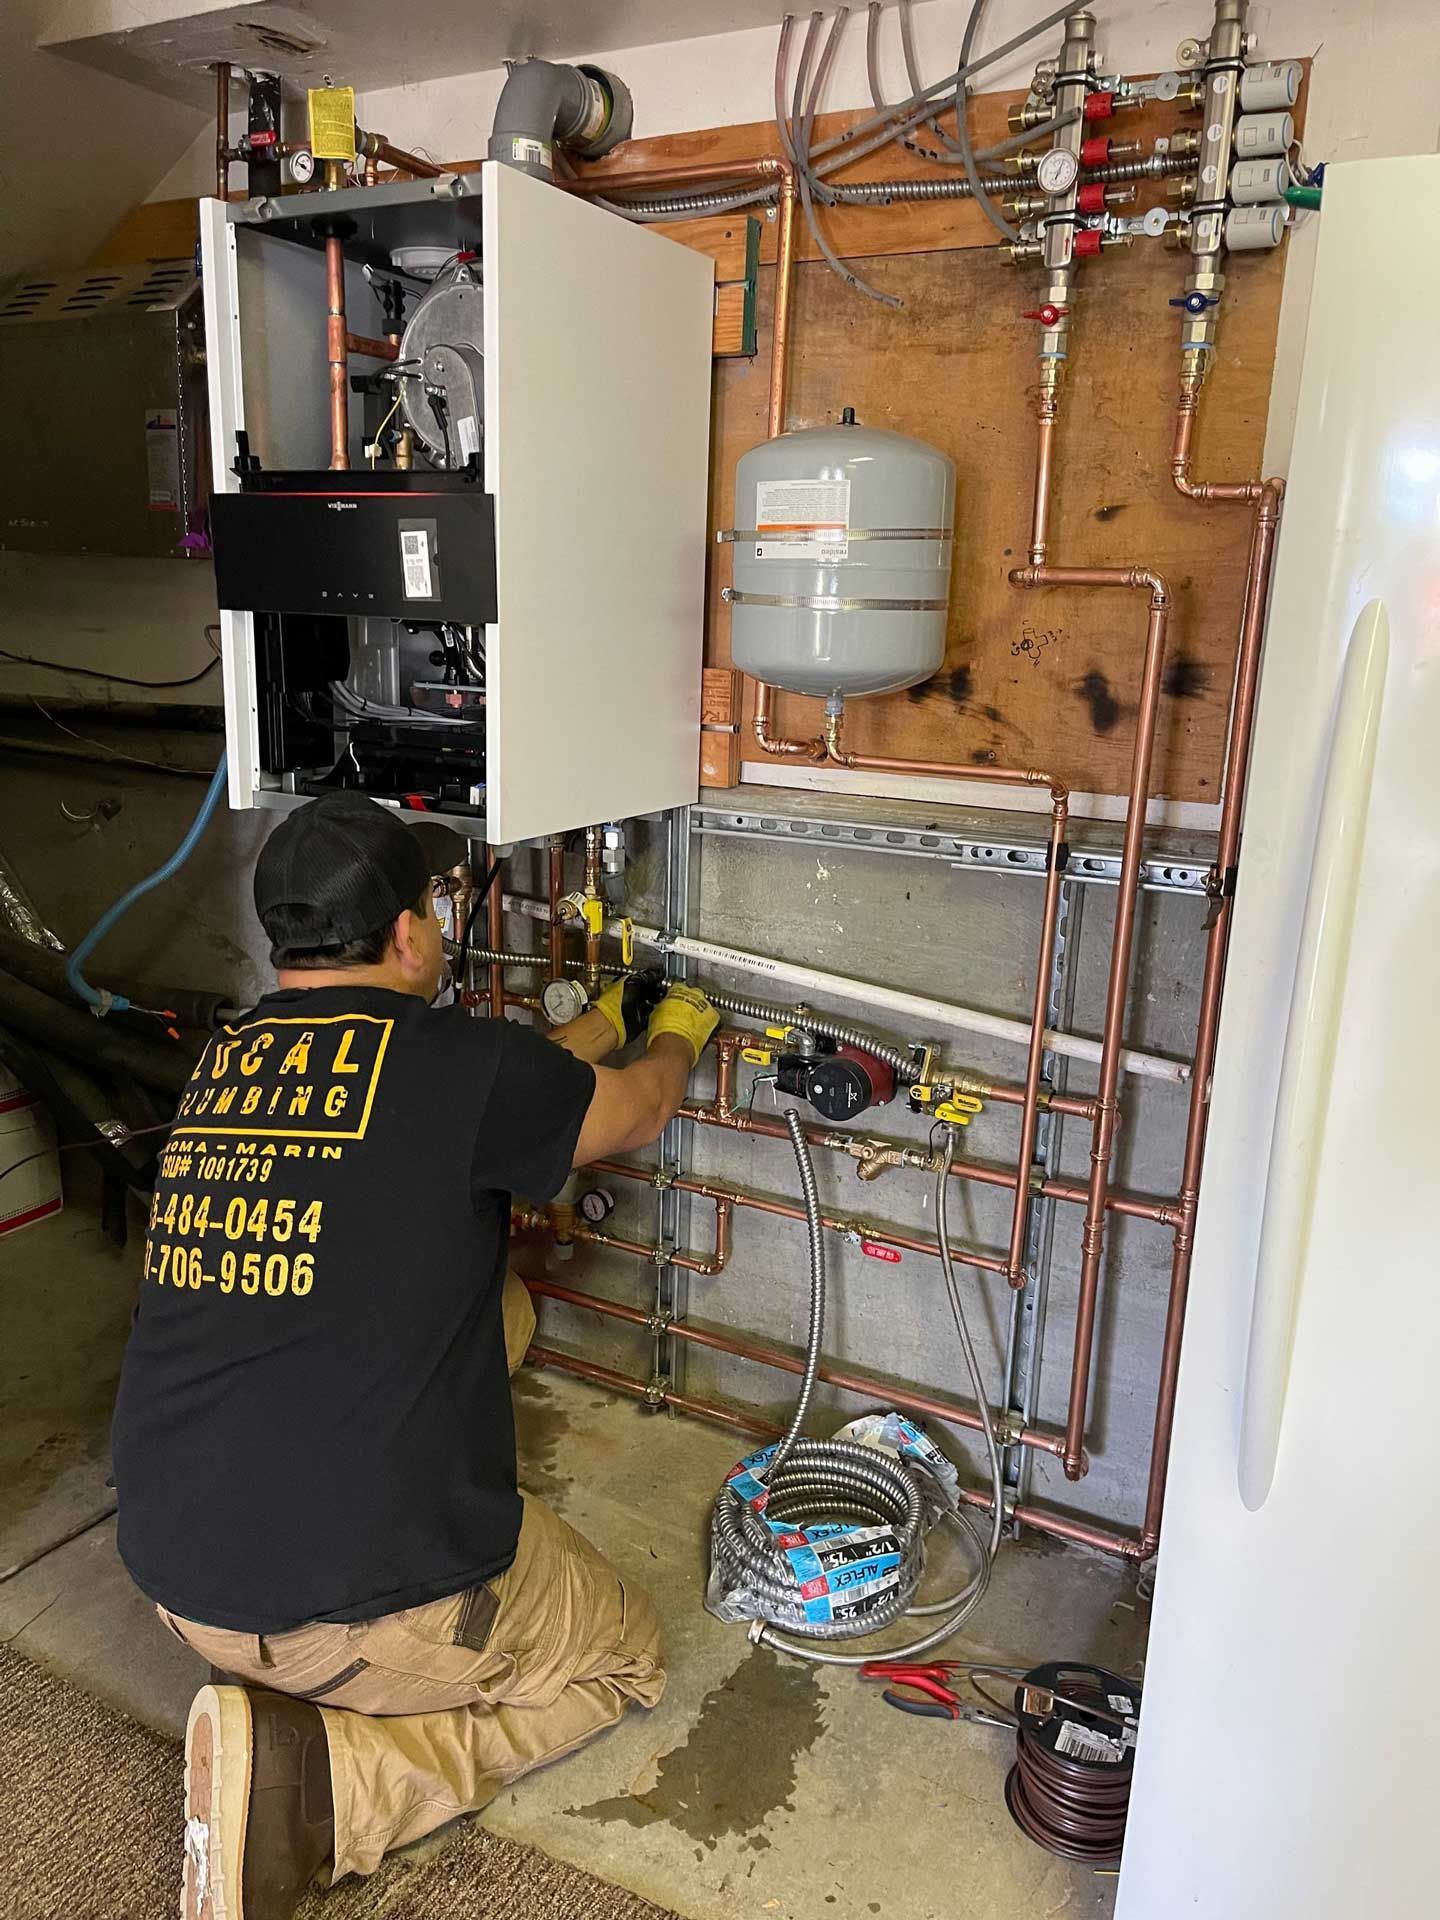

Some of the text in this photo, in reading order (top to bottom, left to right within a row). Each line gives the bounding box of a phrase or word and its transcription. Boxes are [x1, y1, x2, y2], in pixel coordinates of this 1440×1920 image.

[236, 1142, 343, 1160] MARIN
[197, 1156, 273, 1183] 1091739
[834, 1563, 879, 1588] ALFLEX
